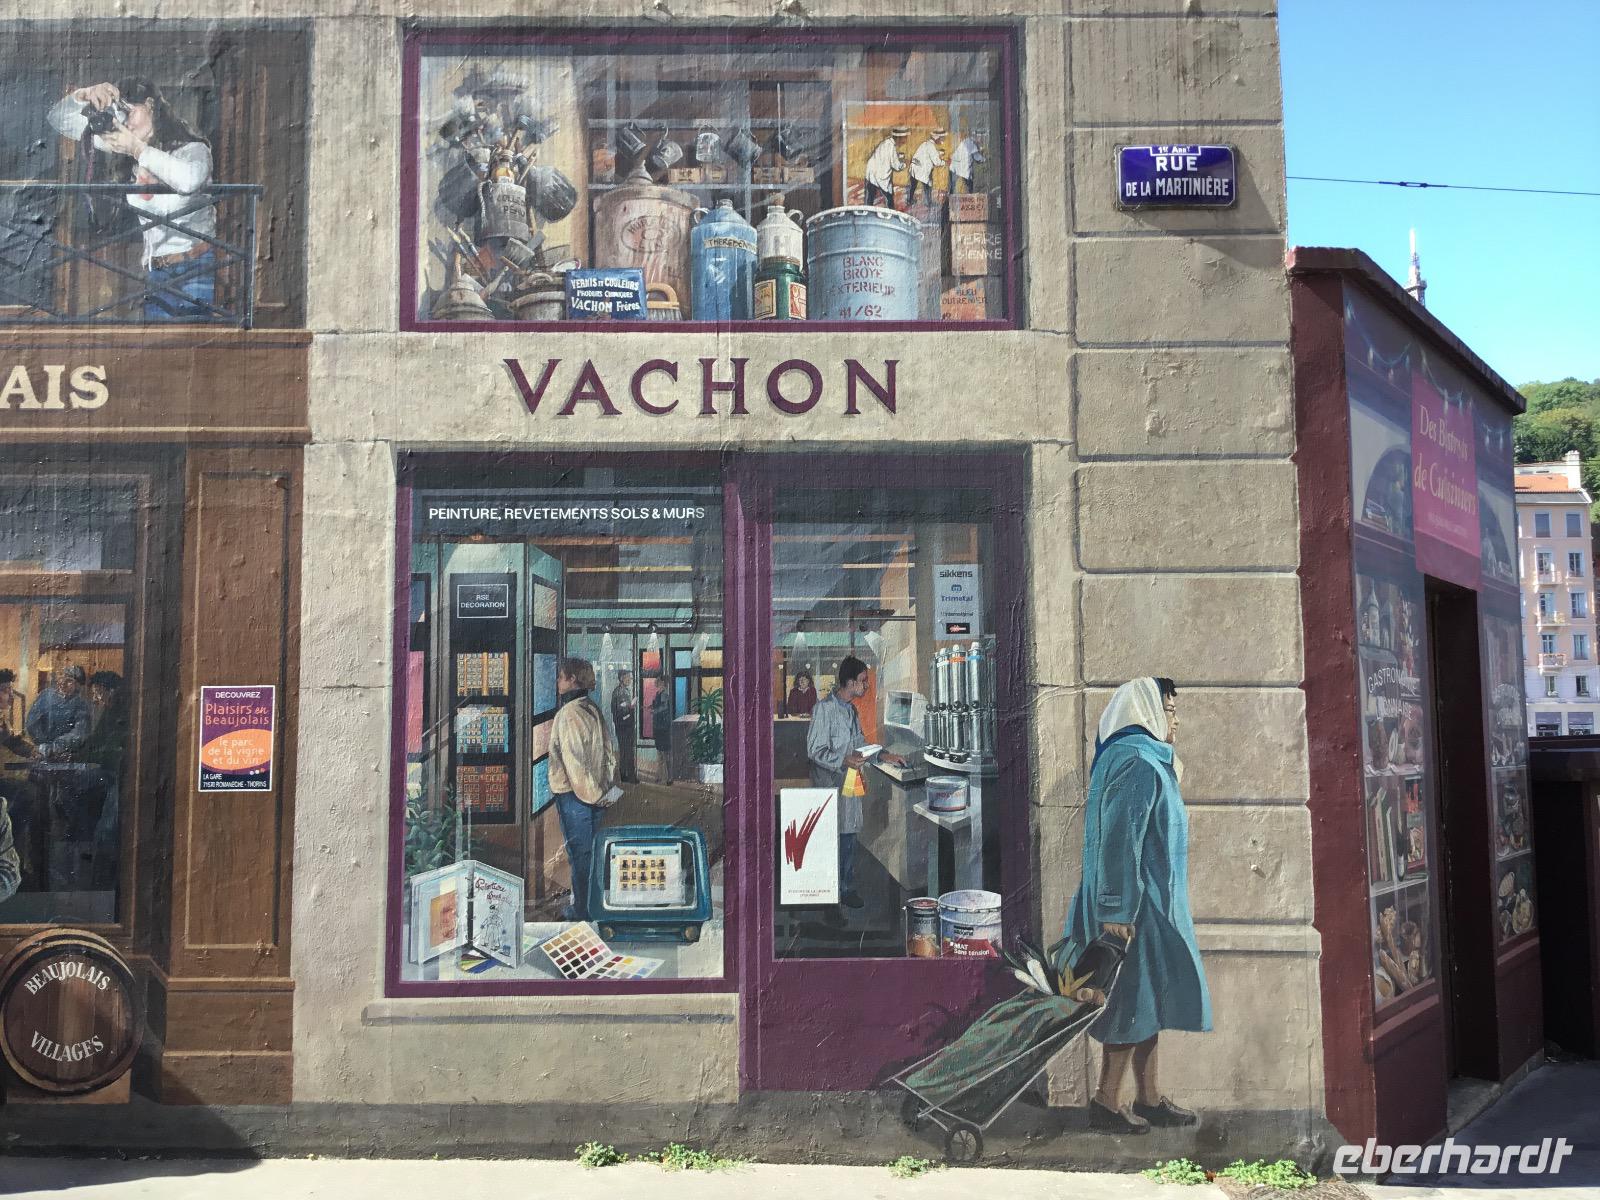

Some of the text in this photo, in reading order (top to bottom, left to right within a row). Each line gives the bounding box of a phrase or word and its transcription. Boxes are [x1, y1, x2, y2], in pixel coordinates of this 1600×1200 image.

[1156, 155, 1198, 172] RUE
[1126, 175, 1229, 197] DE LA MARTINIÈRE
[843, 255, 884, 269] BLANC
[843, 267, 884, 281] BROYE
[570, 278, 598, 289] VERNIS
[604, 277, 639, 291] COULEURS
[571, 297, 613, 313] VACHON
[502, 358, 901, 416] VACHON
[1419, 404, 1438, 443] Des
[1414, 452, 1427, 491] de
[428, 507, 706, 521] PEINTURE, REVETEMENTS SOLS & MURS
[939, 569, 974, 578] sikkens
[215, 691, 261, 699] DECOUVREZ
[205, 703, 268, 715] Plaisirs en
[205, 715, 269, 727] Beaujolais
[219, 738, 253, 748] le parc
[207, 747, 265, 758] de la vigne
[212, 756, 259, 765] et du vin
[24, 961, 111, 995] BEAUJOLAIS
[30, 1030, 104, 1062] VILLAGES
